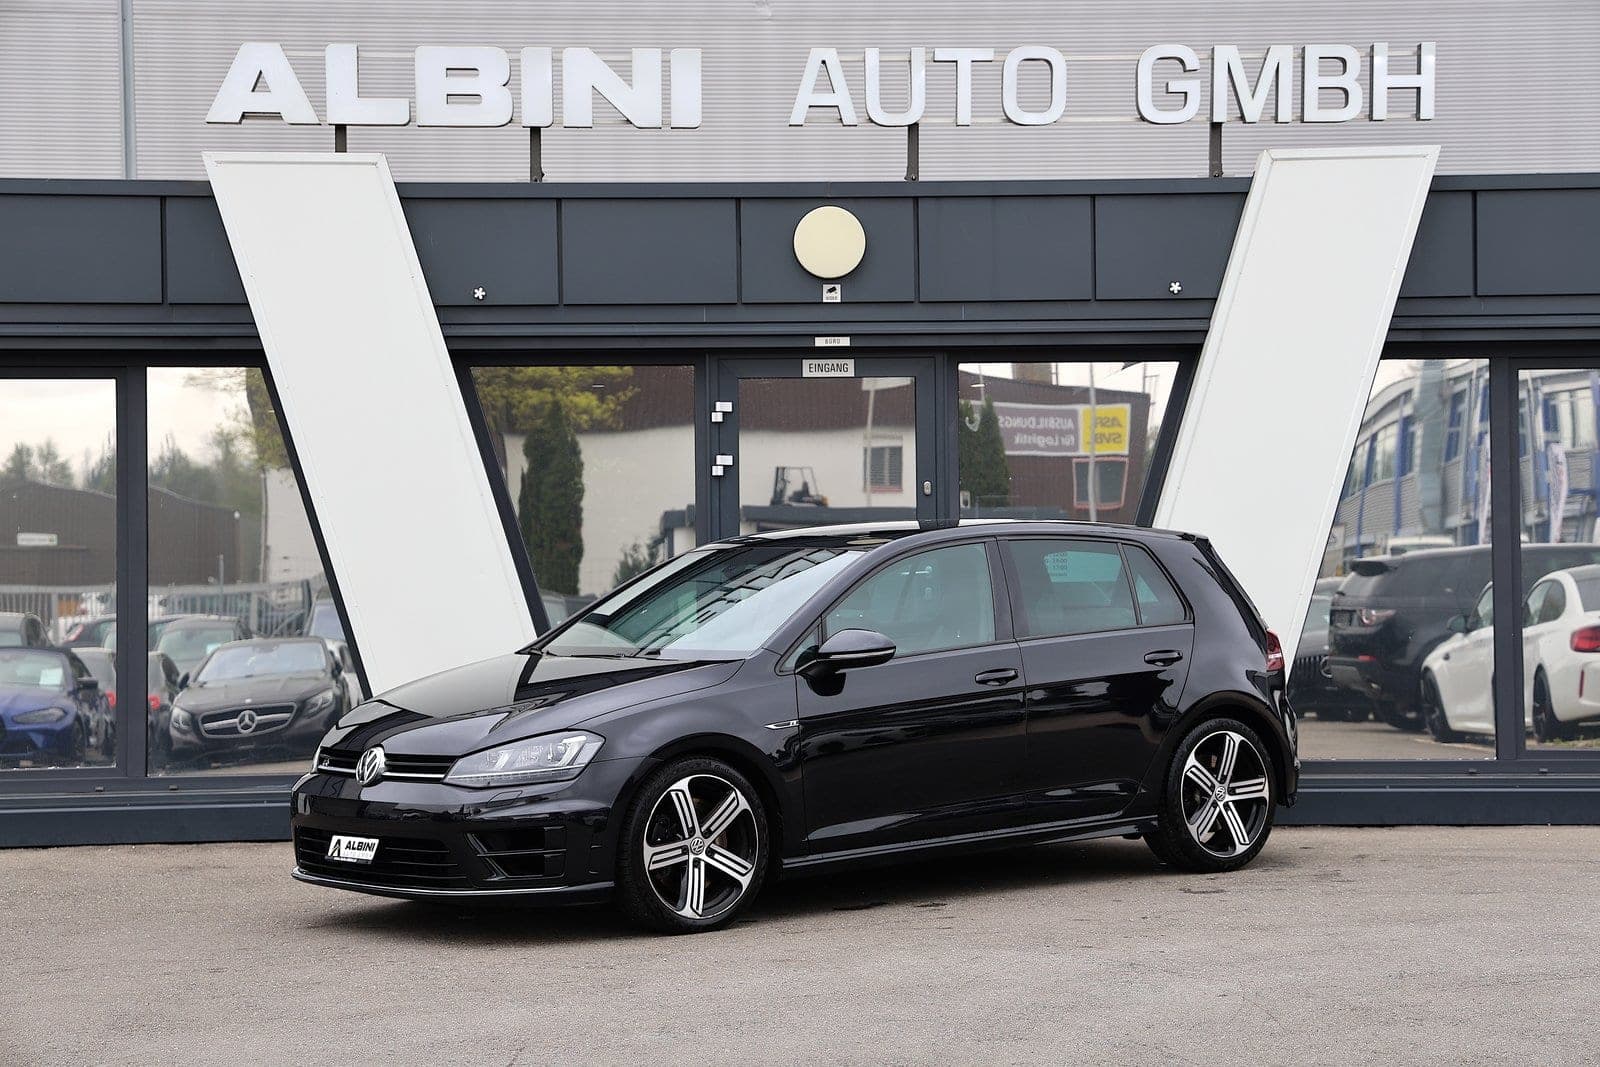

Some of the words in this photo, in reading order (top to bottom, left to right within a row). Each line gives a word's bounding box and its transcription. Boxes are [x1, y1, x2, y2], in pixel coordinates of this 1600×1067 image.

[206, 42, 702, 129] ALBINI
[789, 46, 1067, 127] AUTO
[1136, 42, 1436, 125] GMBH
[808, 362, 849, 373] EINGANG
[345, 840, 376, 853] ALBINI
